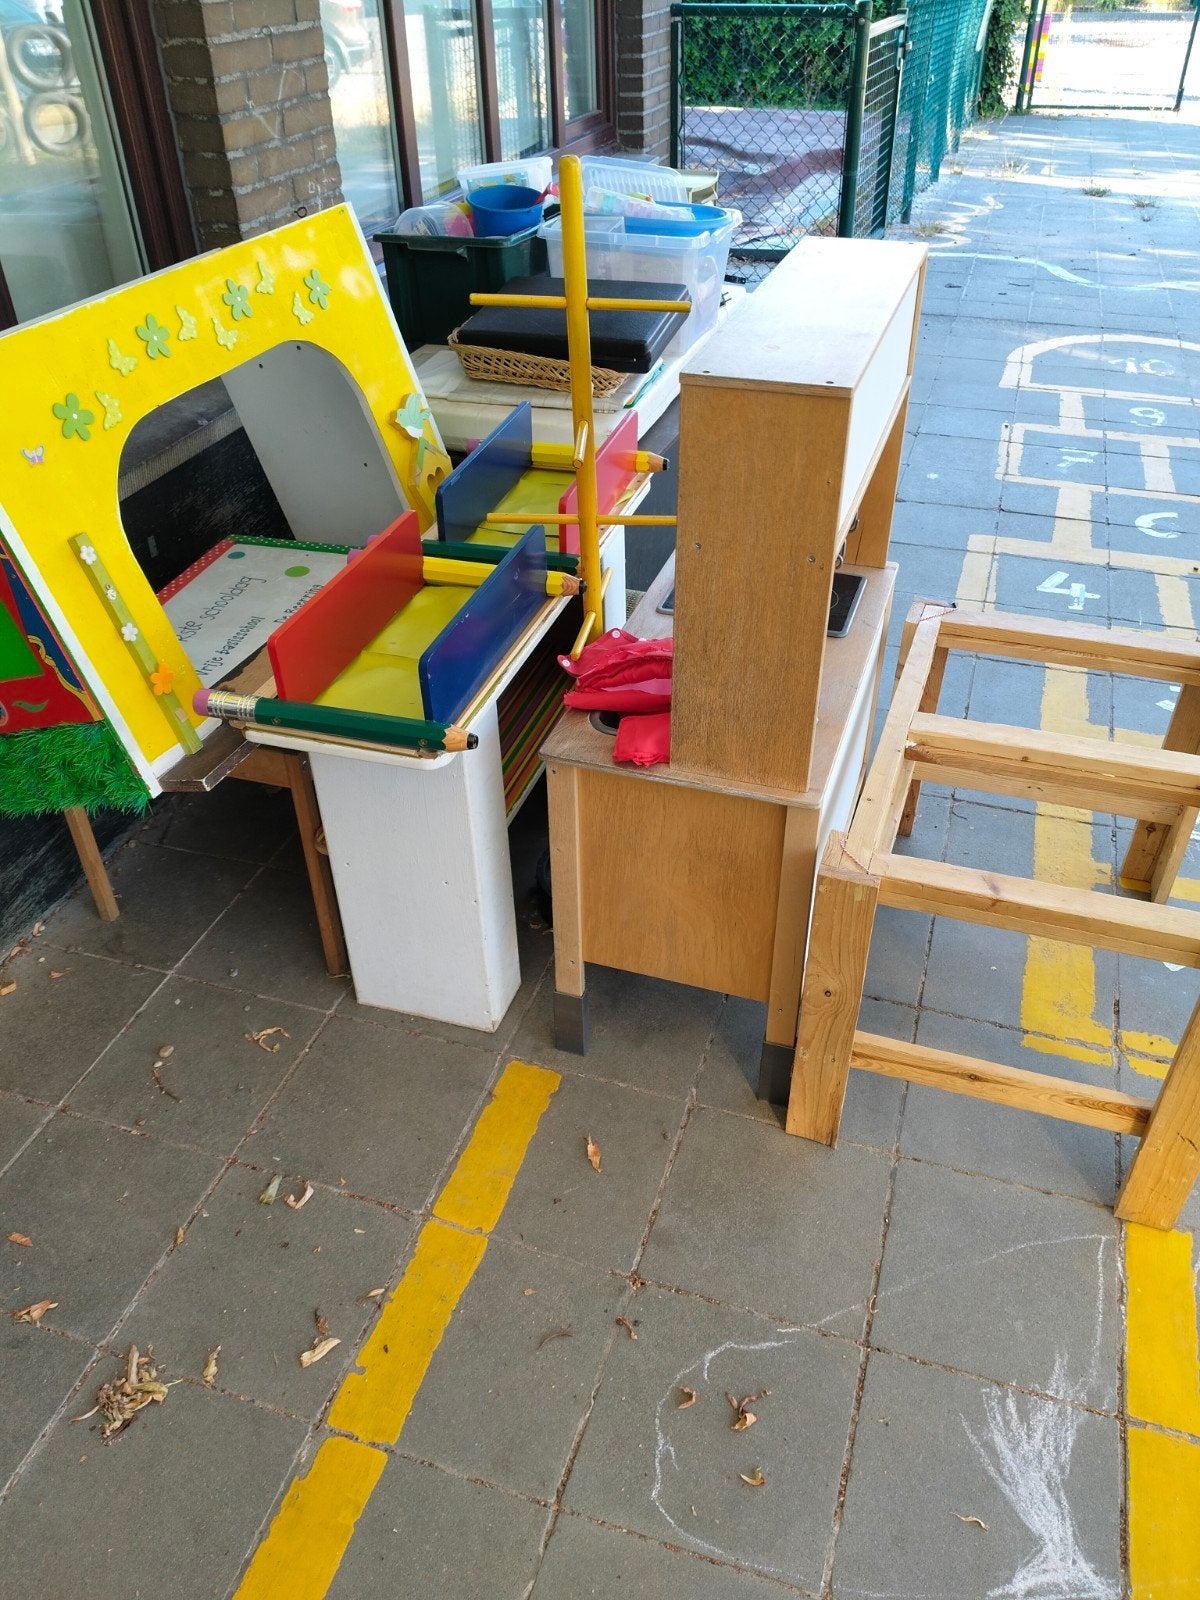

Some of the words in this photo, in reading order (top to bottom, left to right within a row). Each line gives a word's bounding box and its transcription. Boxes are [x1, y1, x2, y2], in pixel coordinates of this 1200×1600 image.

[199, 576, 267, 621] schooldag
[1036, 570, 1101, 610] 4
[214, 616, 266, 655] basisschool
